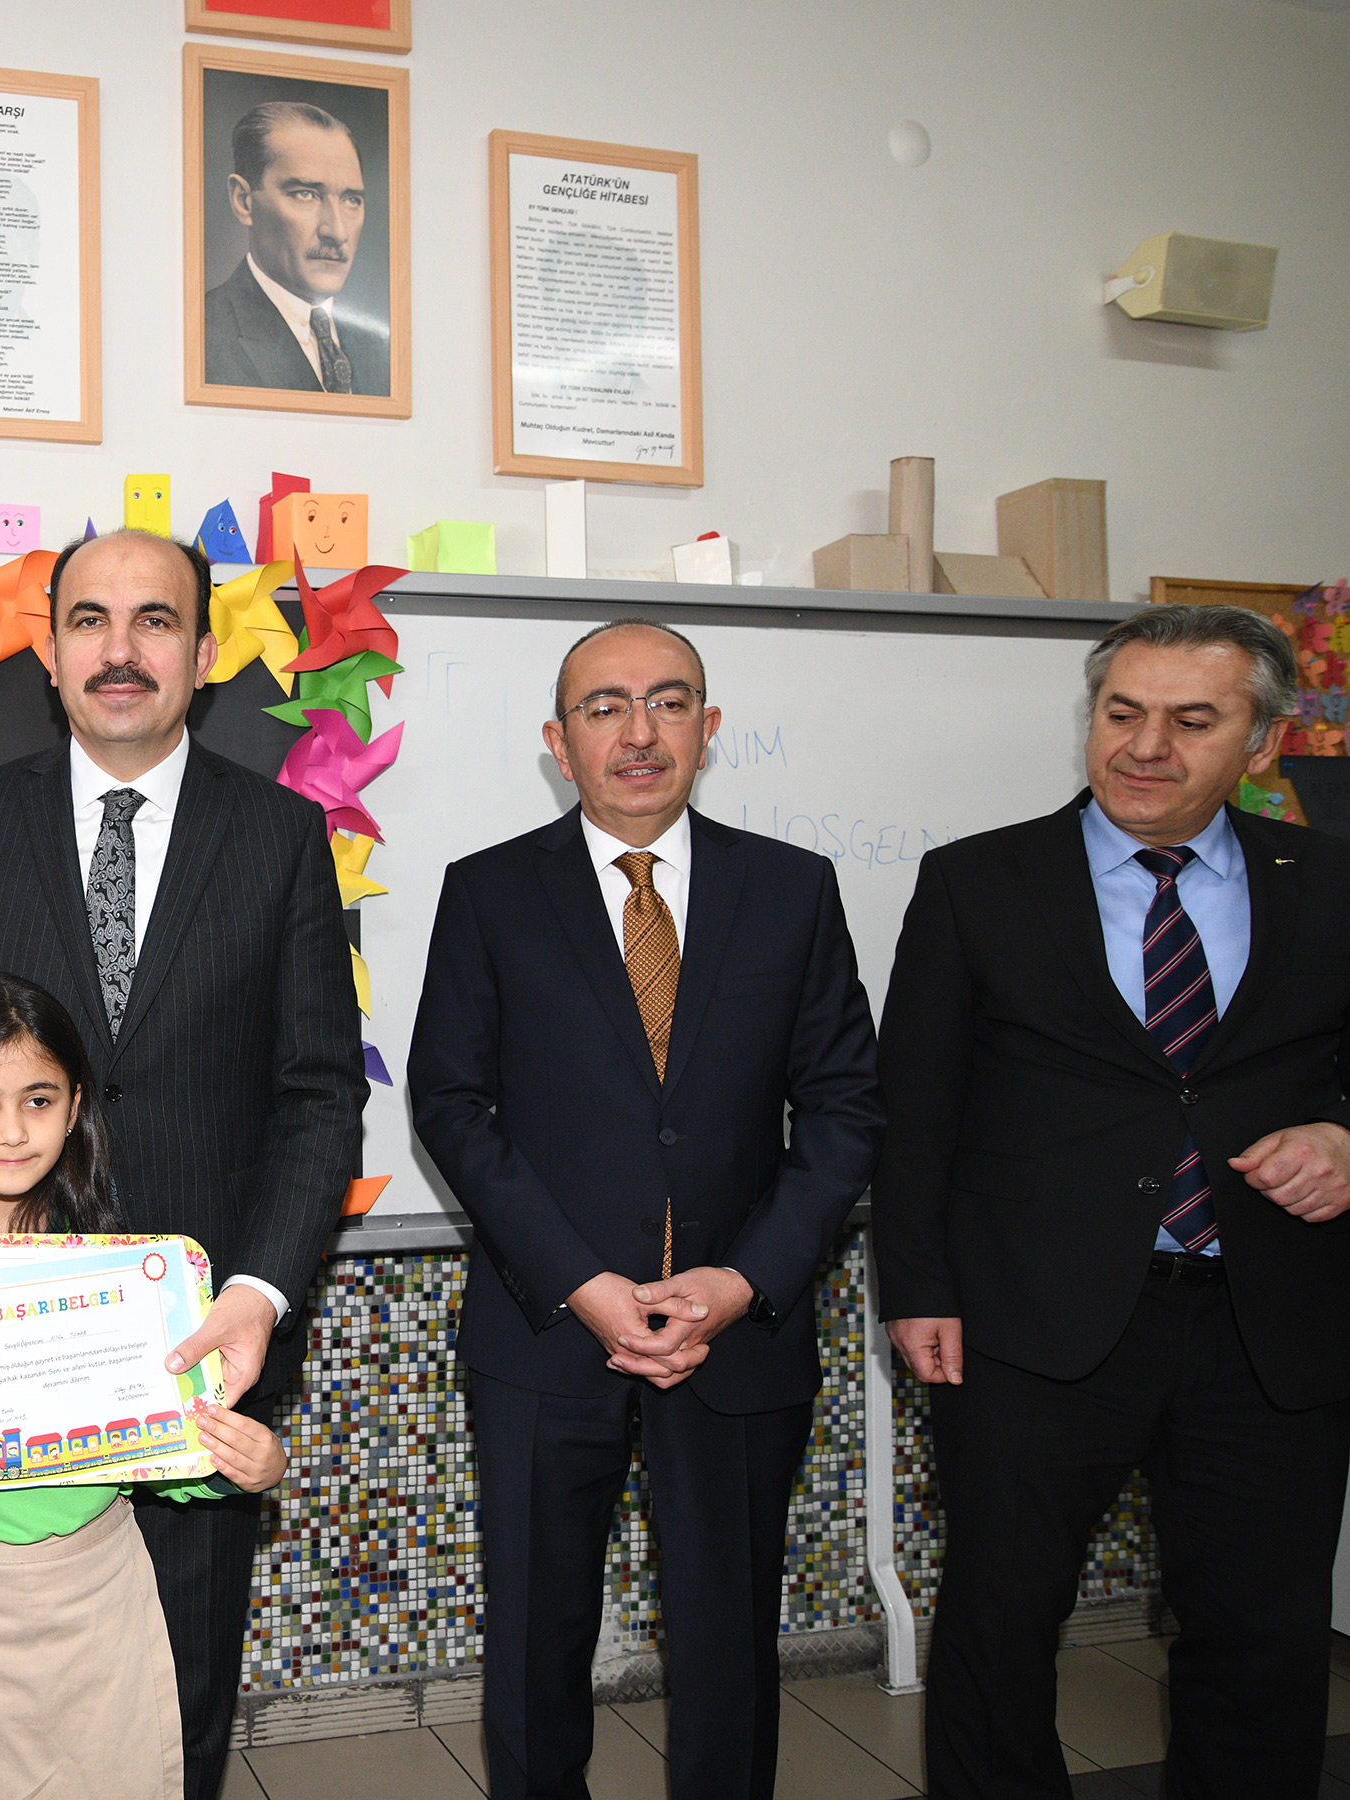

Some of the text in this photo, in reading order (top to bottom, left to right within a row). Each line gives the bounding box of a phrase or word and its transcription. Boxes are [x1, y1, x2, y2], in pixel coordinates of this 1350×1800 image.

[561, 173, 630, 190] ATATÜRK'ÜN
[543, 184, 649, 206] GENÇLİĞE HİTABESİ
[58, 1284, 124, 1312] BELGESİ
